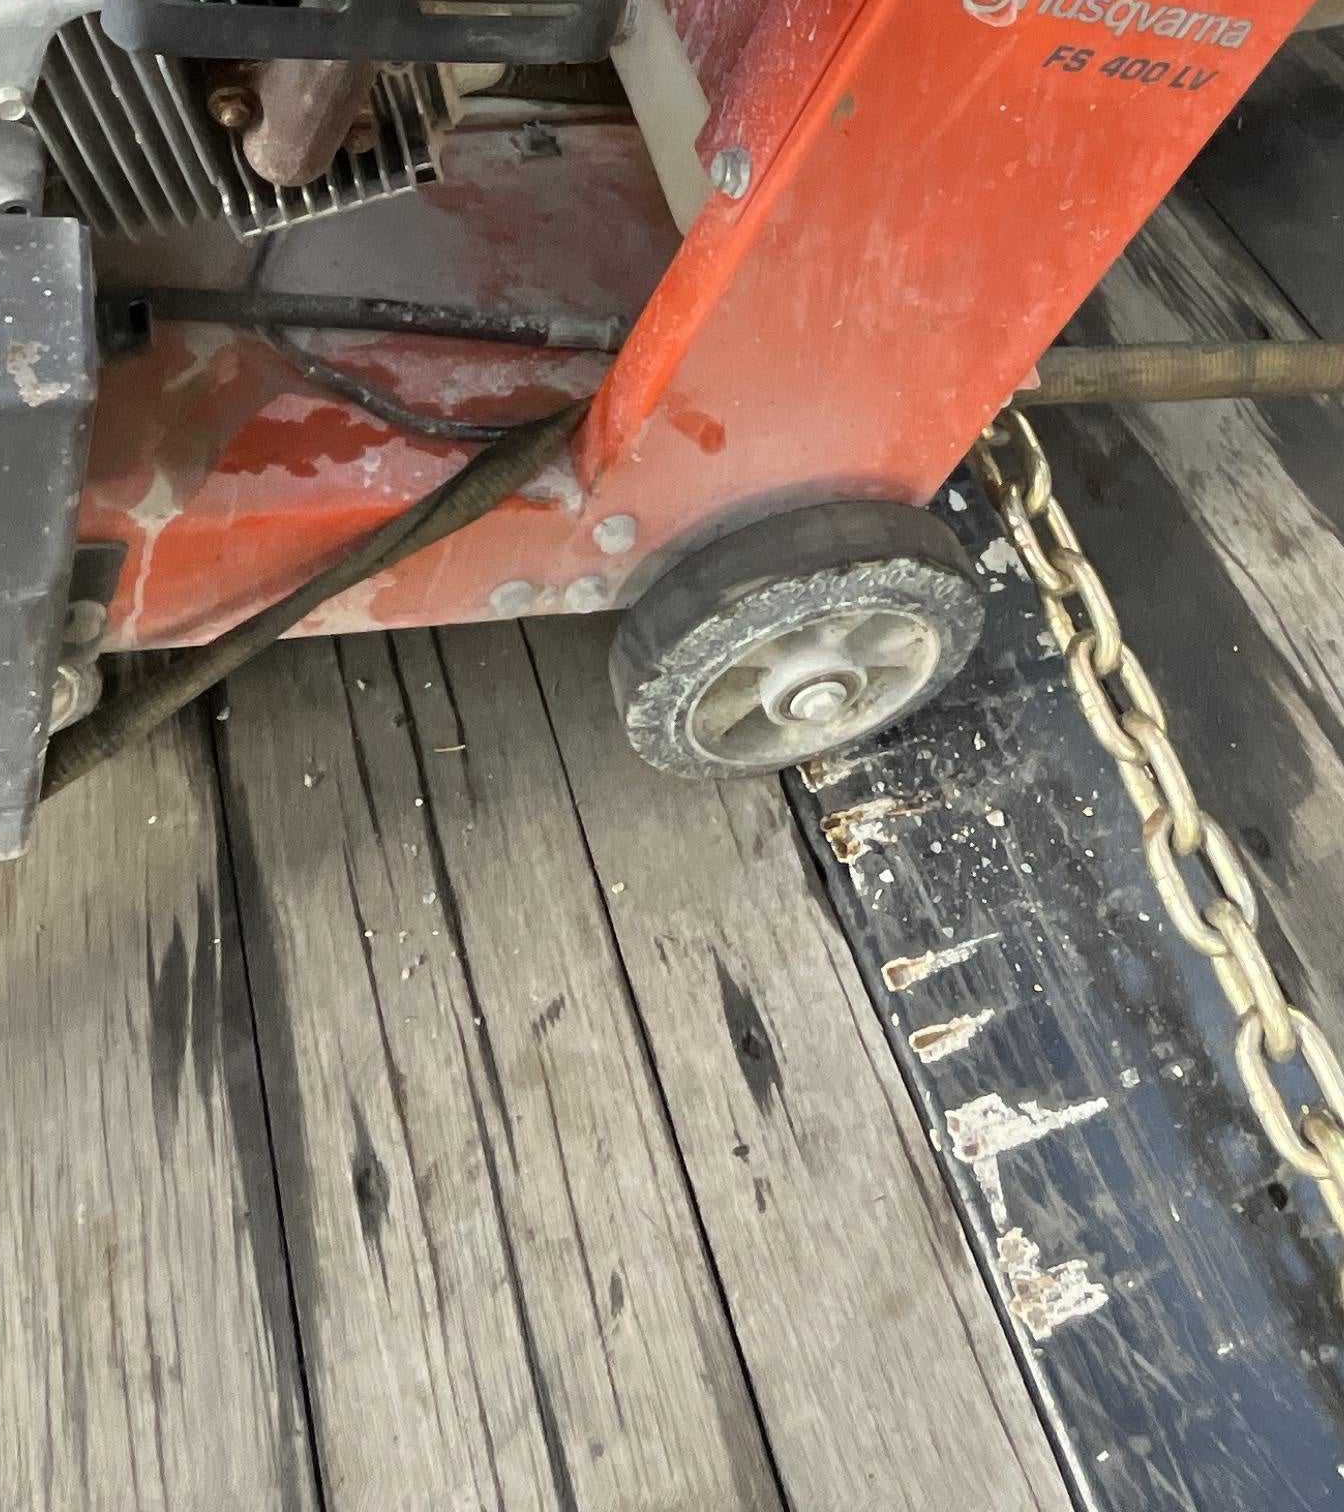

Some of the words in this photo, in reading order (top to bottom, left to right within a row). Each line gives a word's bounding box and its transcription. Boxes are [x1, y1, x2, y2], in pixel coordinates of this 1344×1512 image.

[1041, 45, 1095, 73] FS
[1099, 55, 1171, 84] 400
[1168, 65, 1220, 91] LV
